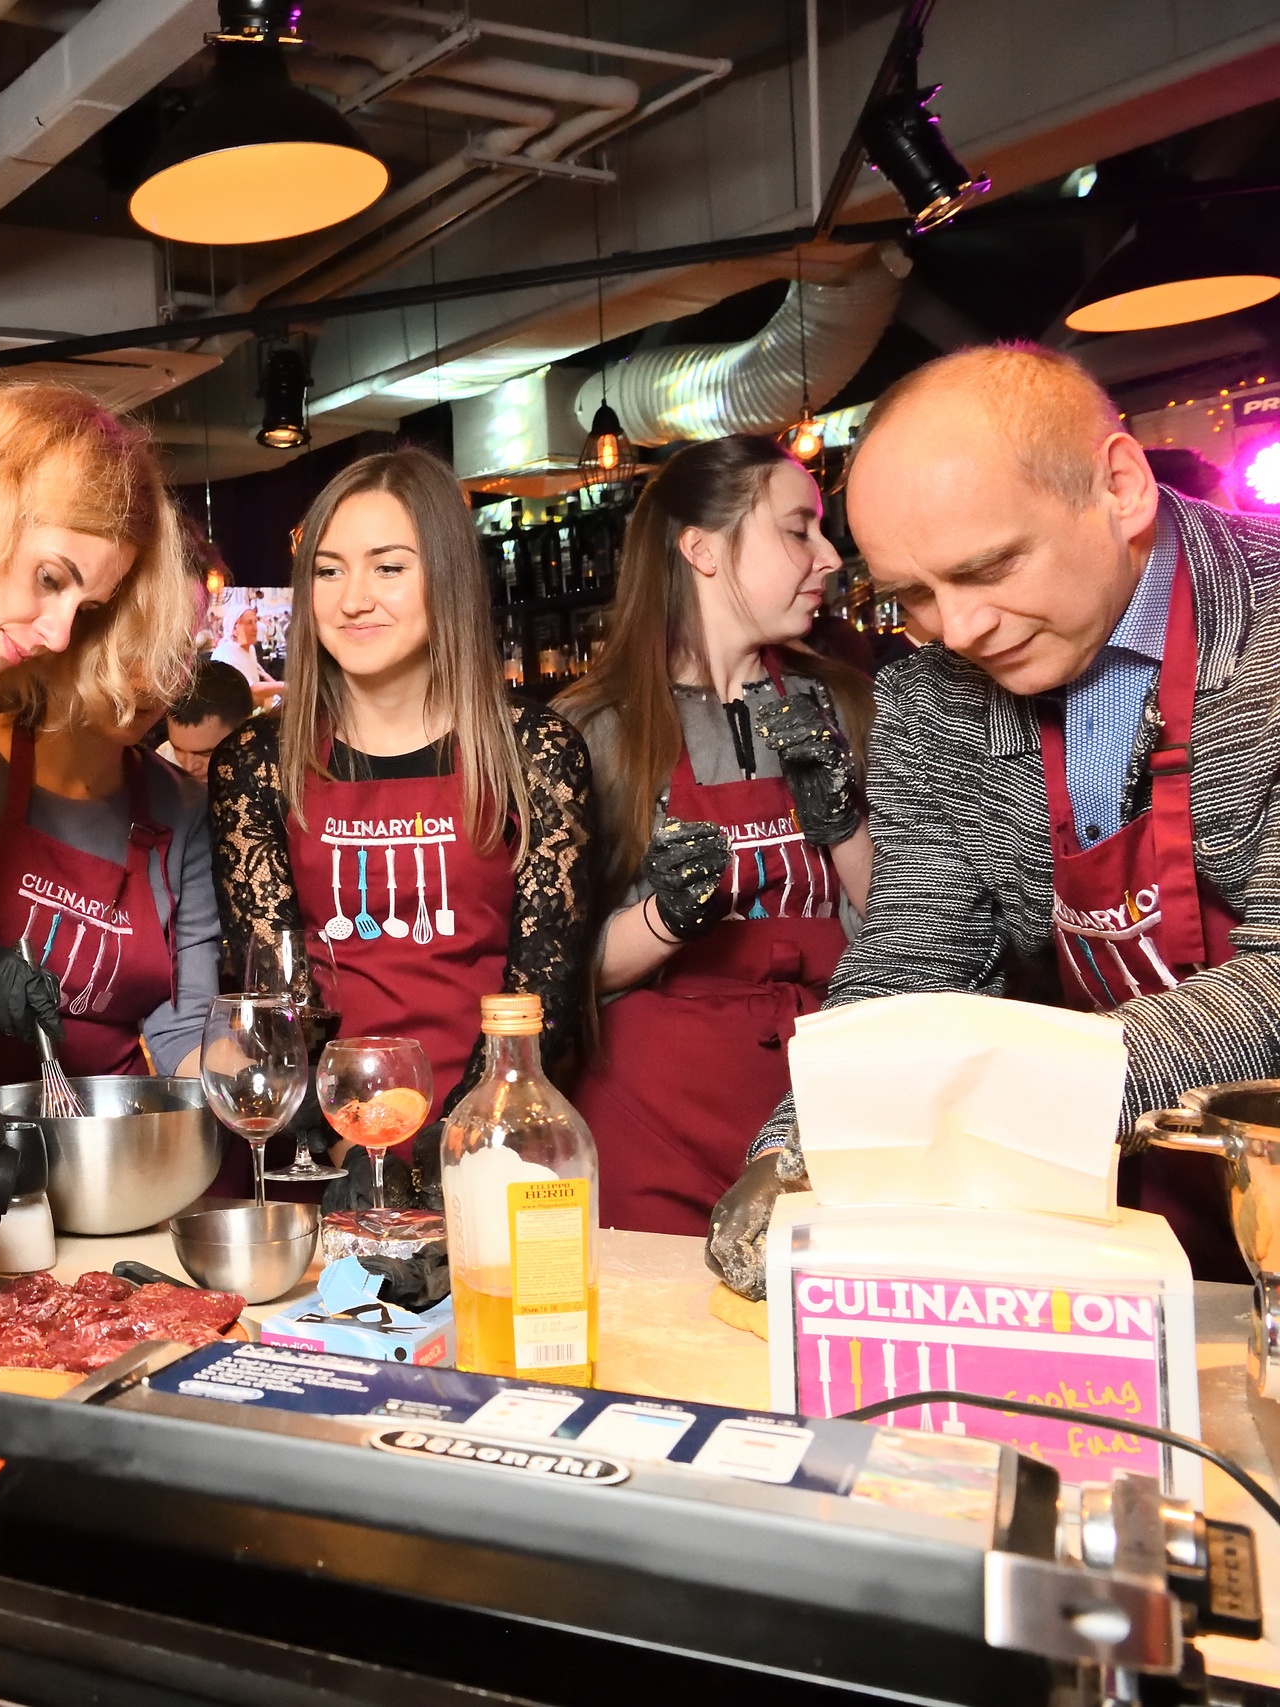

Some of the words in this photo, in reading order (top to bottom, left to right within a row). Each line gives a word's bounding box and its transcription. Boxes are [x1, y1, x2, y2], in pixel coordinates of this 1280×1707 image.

[529, 1182, 570, 1190] FILIPPO
[524, 1188, 575, 1199] BERIO
[394, 1430, 603, 1478] DeLonghi
